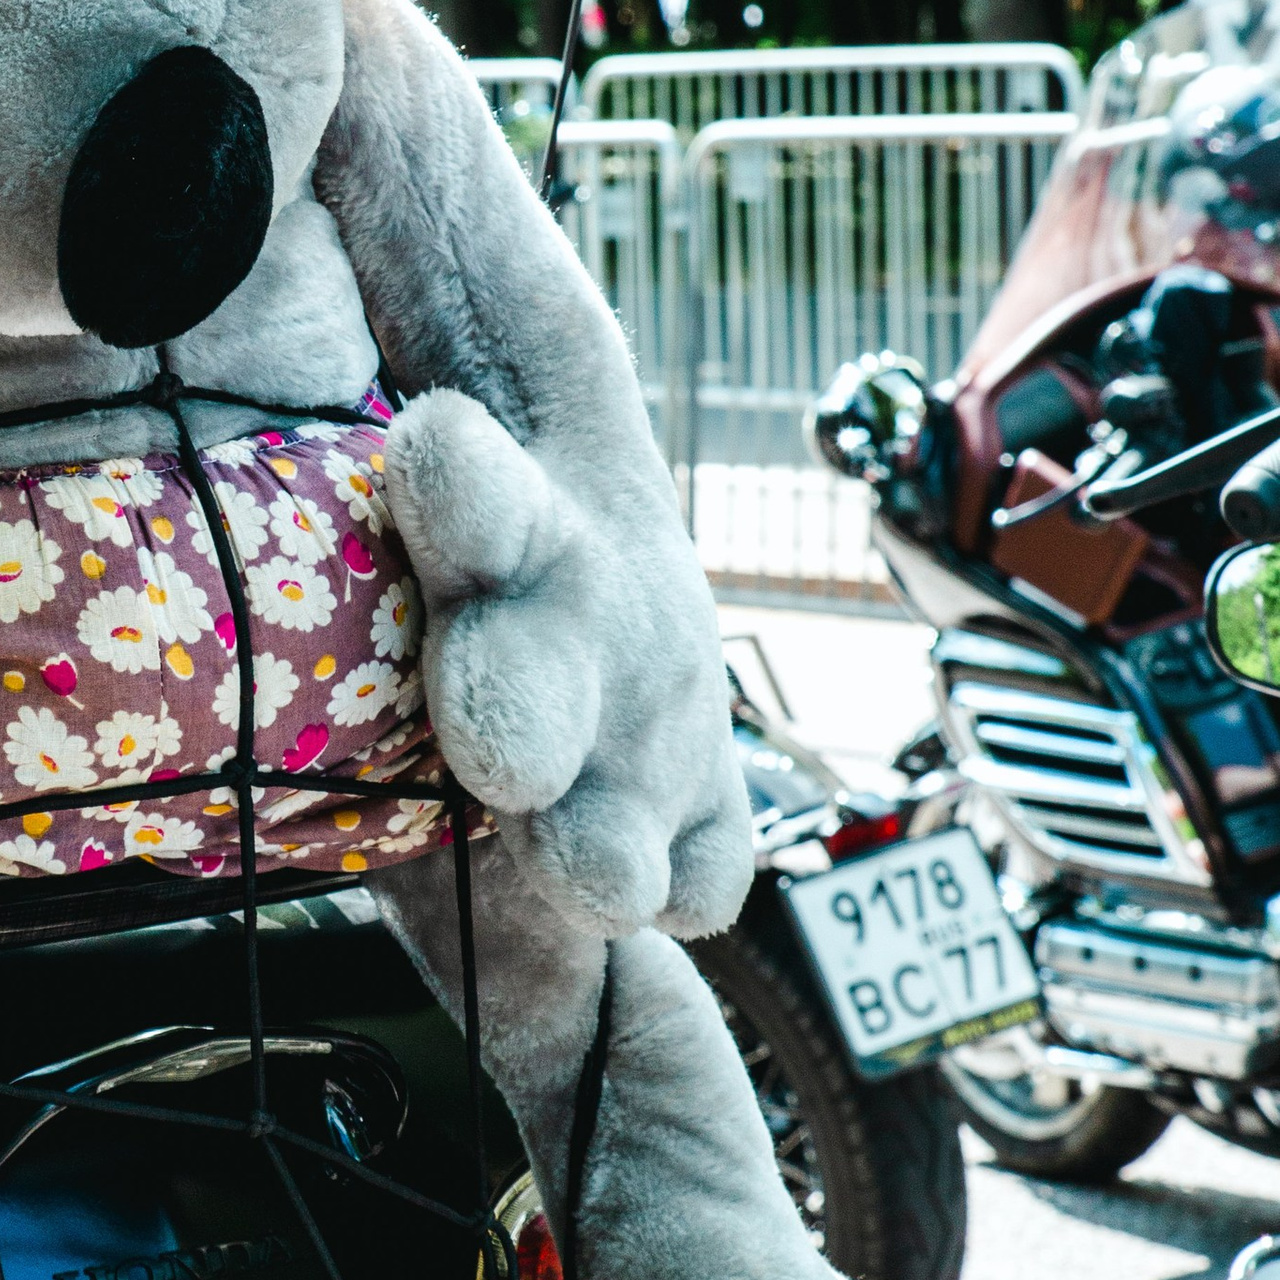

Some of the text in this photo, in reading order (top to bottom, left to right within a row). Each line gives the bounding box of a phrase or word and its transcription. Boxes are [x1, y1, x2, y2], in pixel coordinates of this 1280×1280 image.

[830, 858, 965, 944] 9178
[848, 963, 936, 1036] BC
[943, 934, 1006, 1001] 77
